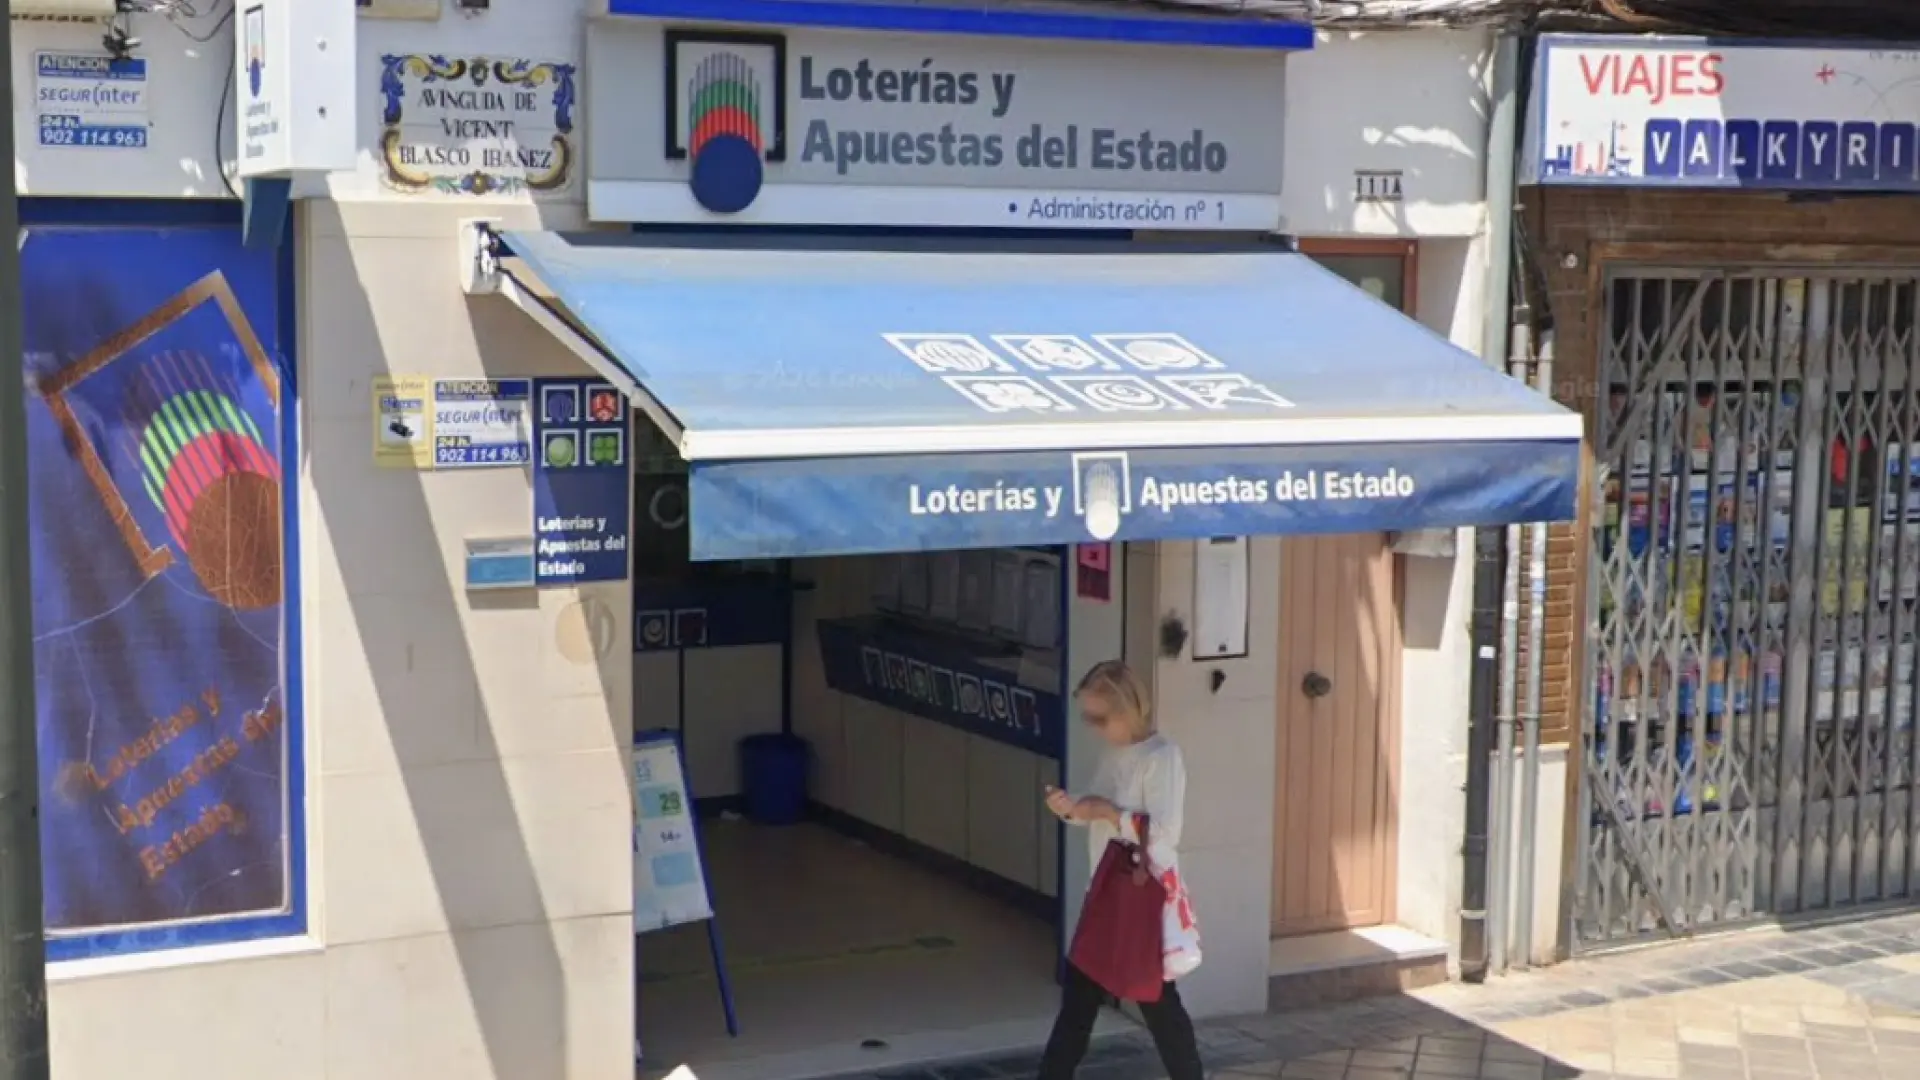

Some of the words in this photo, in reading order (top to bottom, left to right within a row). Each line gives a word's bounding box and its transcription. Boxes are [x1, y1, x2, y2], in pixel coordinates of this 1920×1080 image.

[800, 56, 978, 104] Loterías
[991, 73, 1015, 117] y
[1579, 54, 1724, 104] VIAJES
[419, 88, 505, 111] AVINGUDA
[514, 92, 537, 112] DE
[44, 129, 74, 144] 902
[81, 130, 111, 145] 114
[115, 130, 145, 146] 963
[440, 118, 514, 139] VICENT
[400, 145, 470, 166] BLASCO
[802, 119, 1003, 175] Apuestas
[1016, 125, 1077, 168] del
[1091, 129, 1228, 172] Estado
[1028, 196, 1175, 221] Administración
[1216, 202, 1225, 221] 1
[439, 448, 466, 461] 902
[472, 449, 497, 461] 114
[910, 480, 1037, 514] Loterías
[1043, 486, 1063, 517] y
[1141, 475, 1268, 513] Apuestas
[1275, 470, 1317, 501] del
[1324, 467, 1415, 499] Estado
[538, 514, 595, 532] Loterías
[597, 517, 607, 533] y
[538, 537, 601, 558] Apuestas
[603, 534, 626, 551] del
[538, 558, 585, 576] Estado
